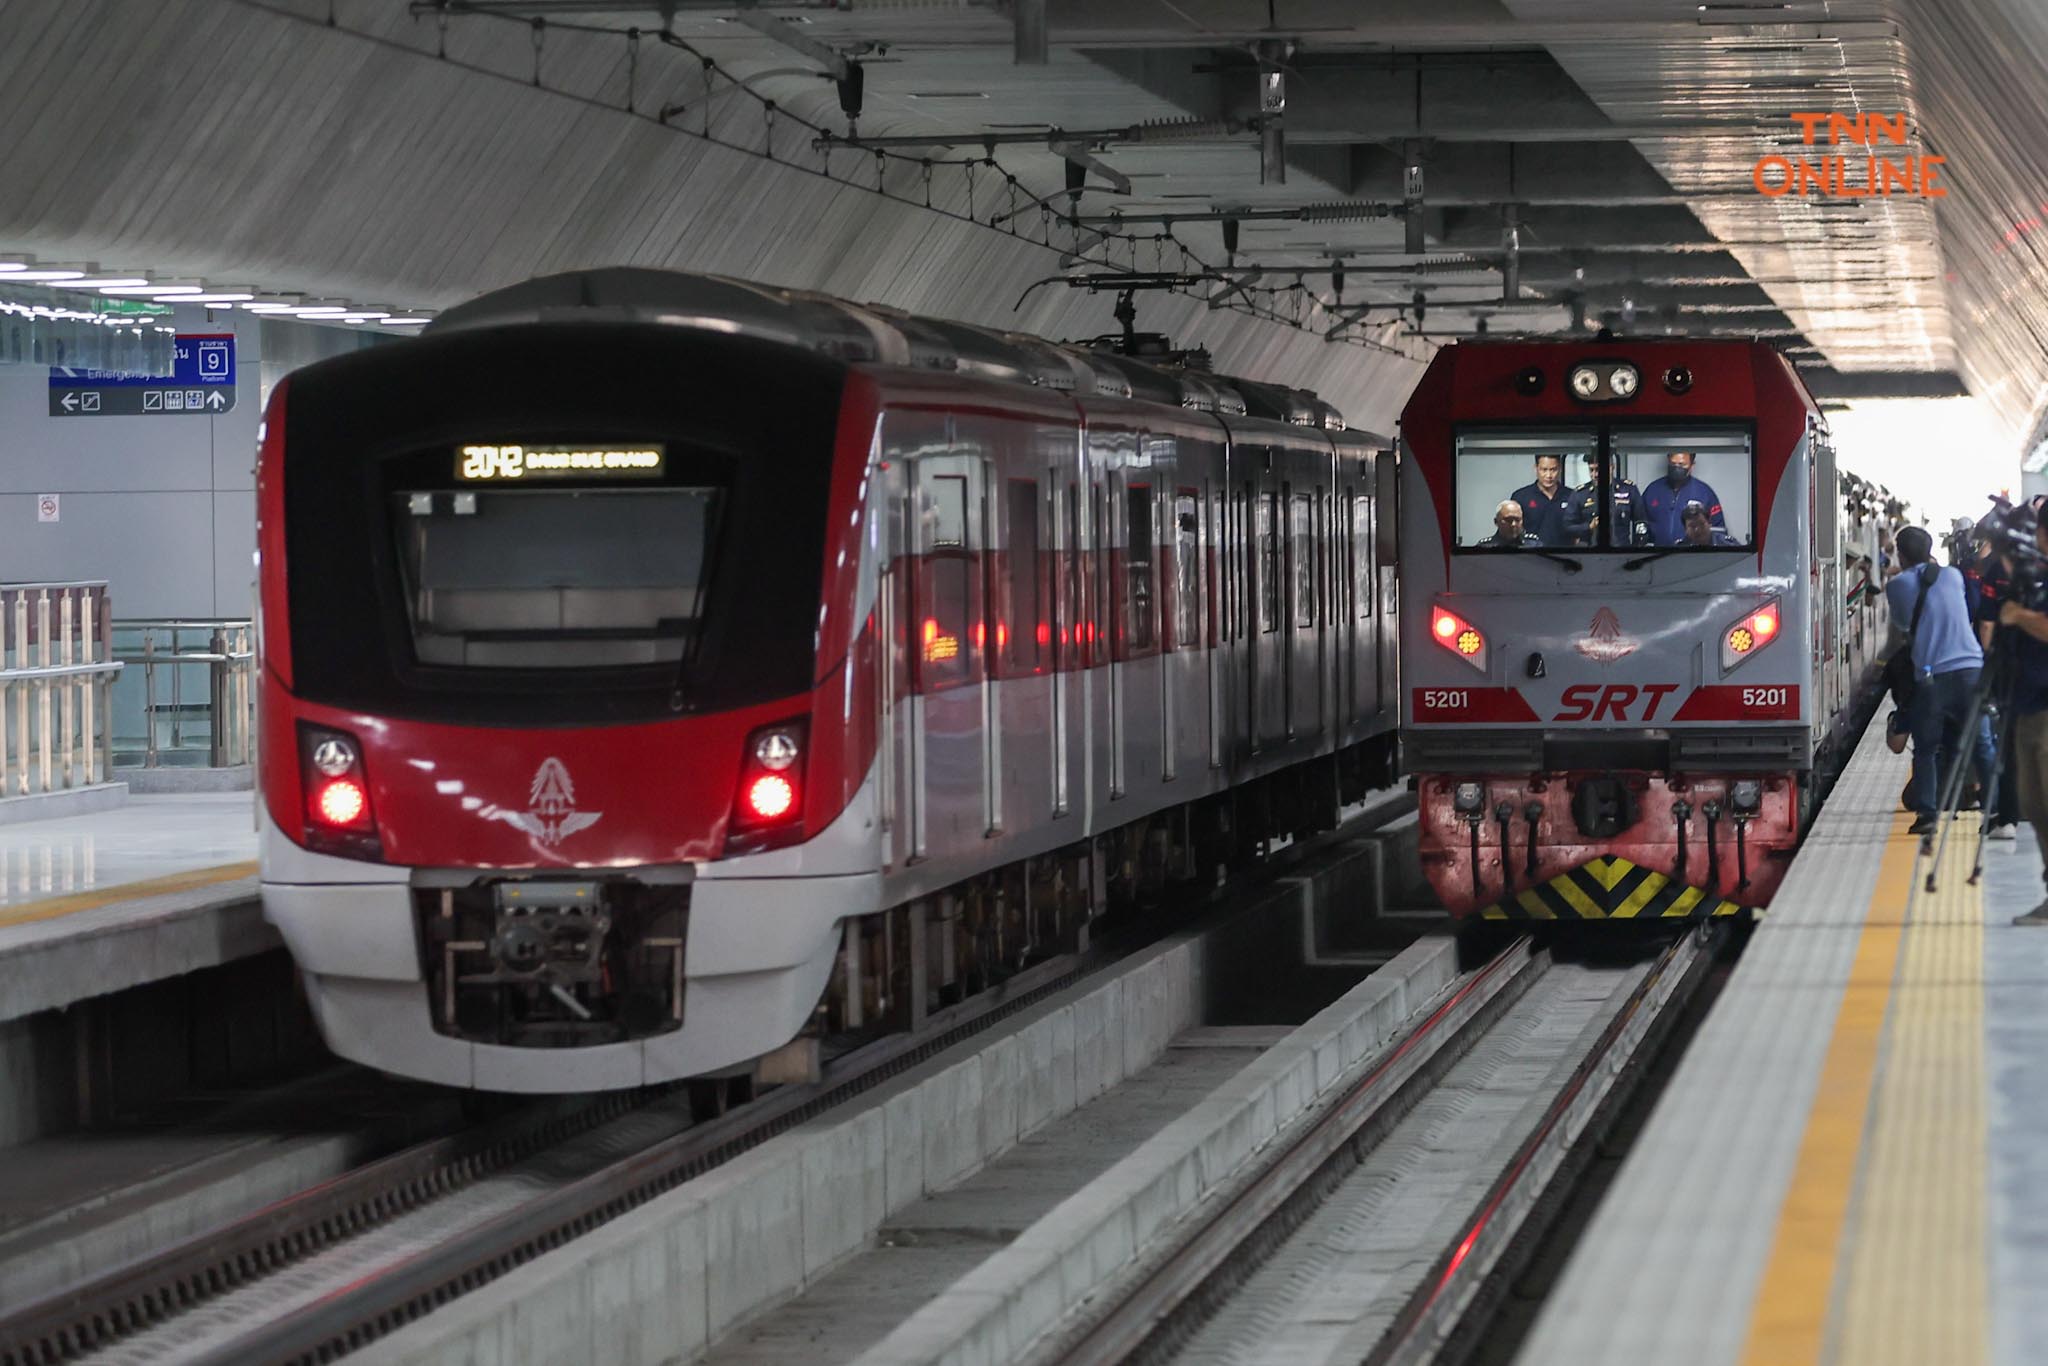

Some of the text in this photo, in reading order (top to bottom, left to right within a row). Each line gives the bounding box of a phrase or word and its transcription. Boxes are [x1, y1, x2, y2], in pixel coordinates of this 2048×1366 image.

[208, 353, 219, 370] 9
[1424, 691, 1468, 708] 5201
[1552, 684, 1680, 722] SRT
[1743, 688, 1787, 706] 5201
